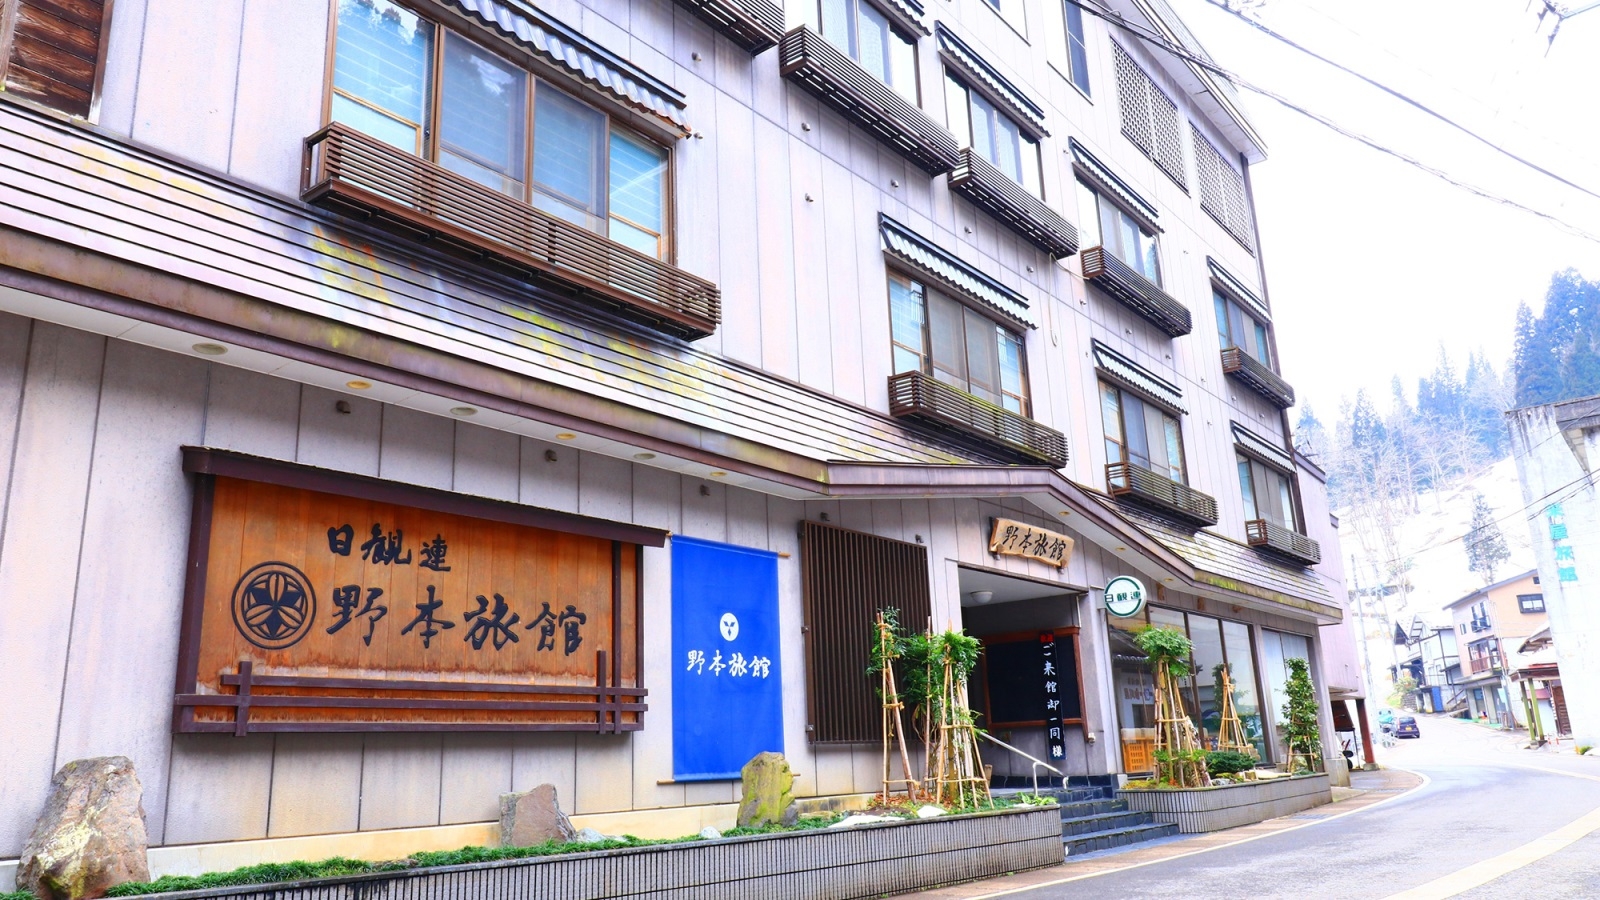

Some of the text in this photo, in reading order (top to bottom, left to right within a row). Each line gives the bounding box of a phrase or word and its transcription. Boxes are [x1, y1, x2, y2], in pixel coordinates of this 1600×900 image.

[1002, 526, 1066, 561] 野本旅館
[326, 584, 587, 656] 野本旅館
[687, 649, 771, 679] 野本旅館
[1043, 642, 1063, 758] ご来館御一同様
